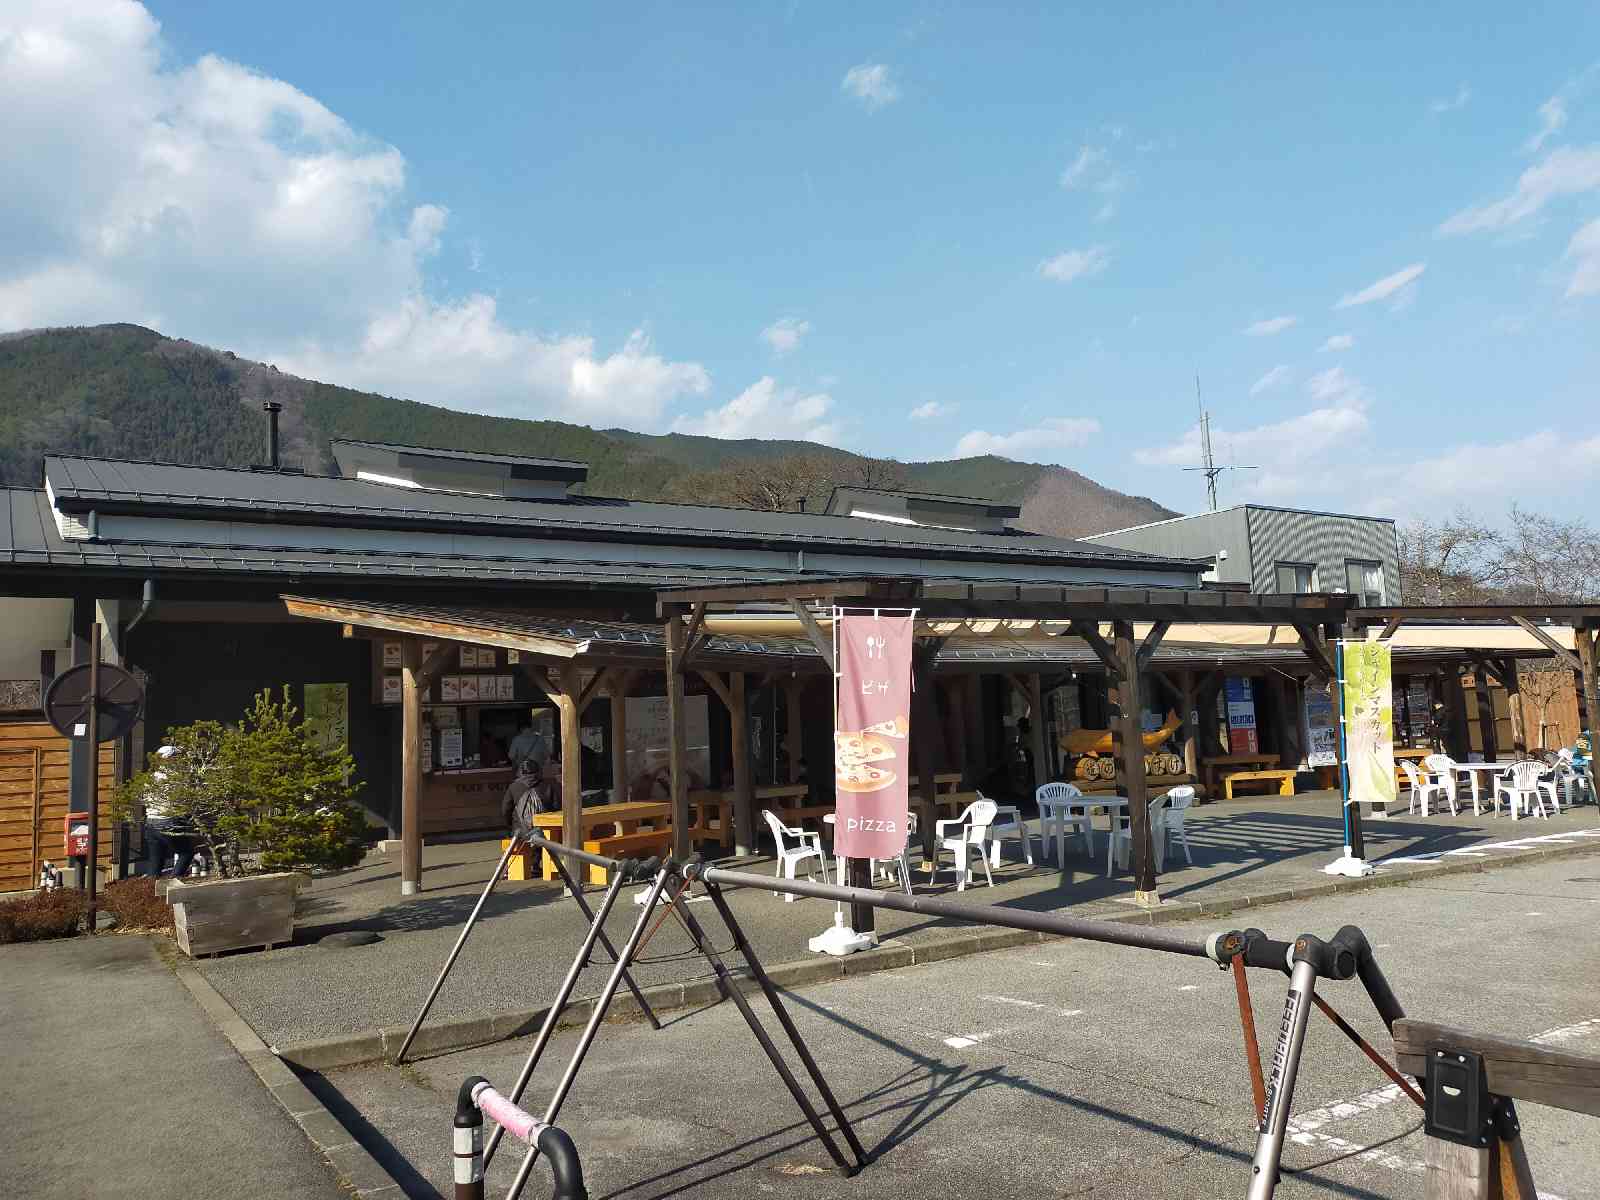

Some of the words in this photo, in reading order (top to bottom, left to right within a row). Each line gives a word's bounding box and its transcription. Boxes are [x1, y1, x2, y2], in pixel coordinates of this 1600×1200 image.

[1370, 645, 1381, 755] シャインマスカット
[847, 815, 897, 833] pizza
